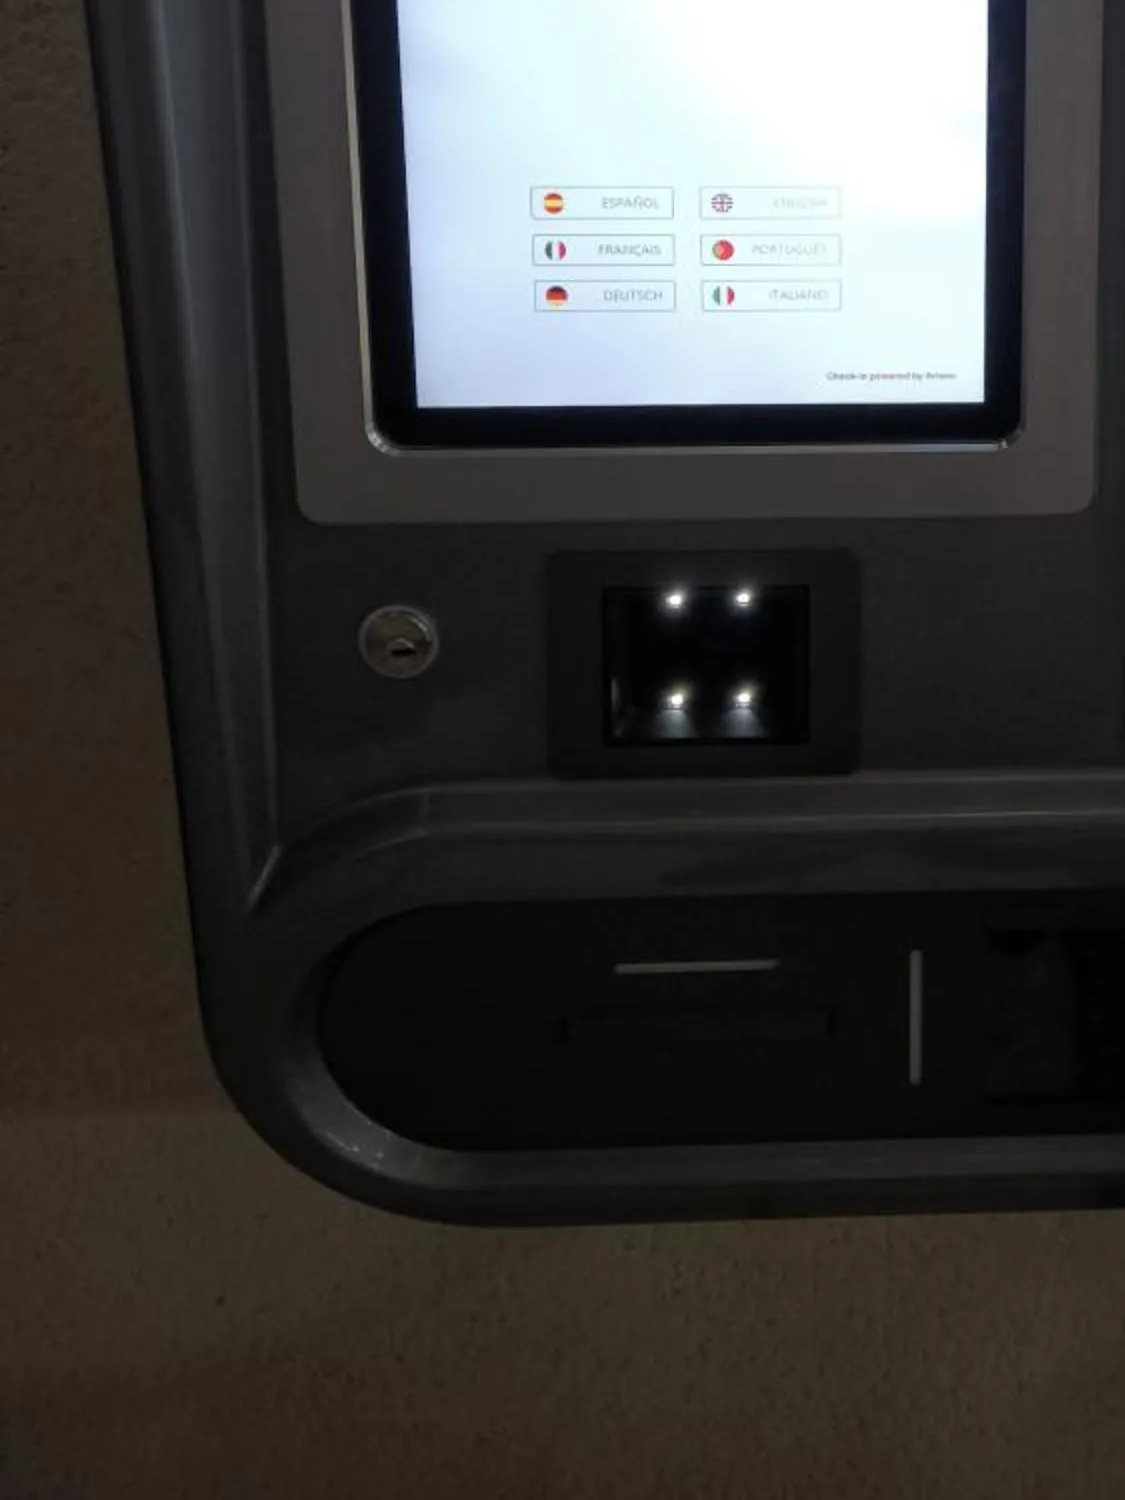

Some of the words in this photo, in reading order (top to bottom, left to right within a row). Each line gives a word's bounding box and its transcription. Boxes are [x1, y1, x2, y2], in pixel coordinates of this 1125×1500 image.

[601, 195, 660, 209] ESPAÑOL
[597, 244, 662, 258] FRANÇAIS
[603, 289, 663, 301] DEUTSCH
[768, 289, 828, 301] ITALIANO
[825, 371, 868, 381] Check-in
